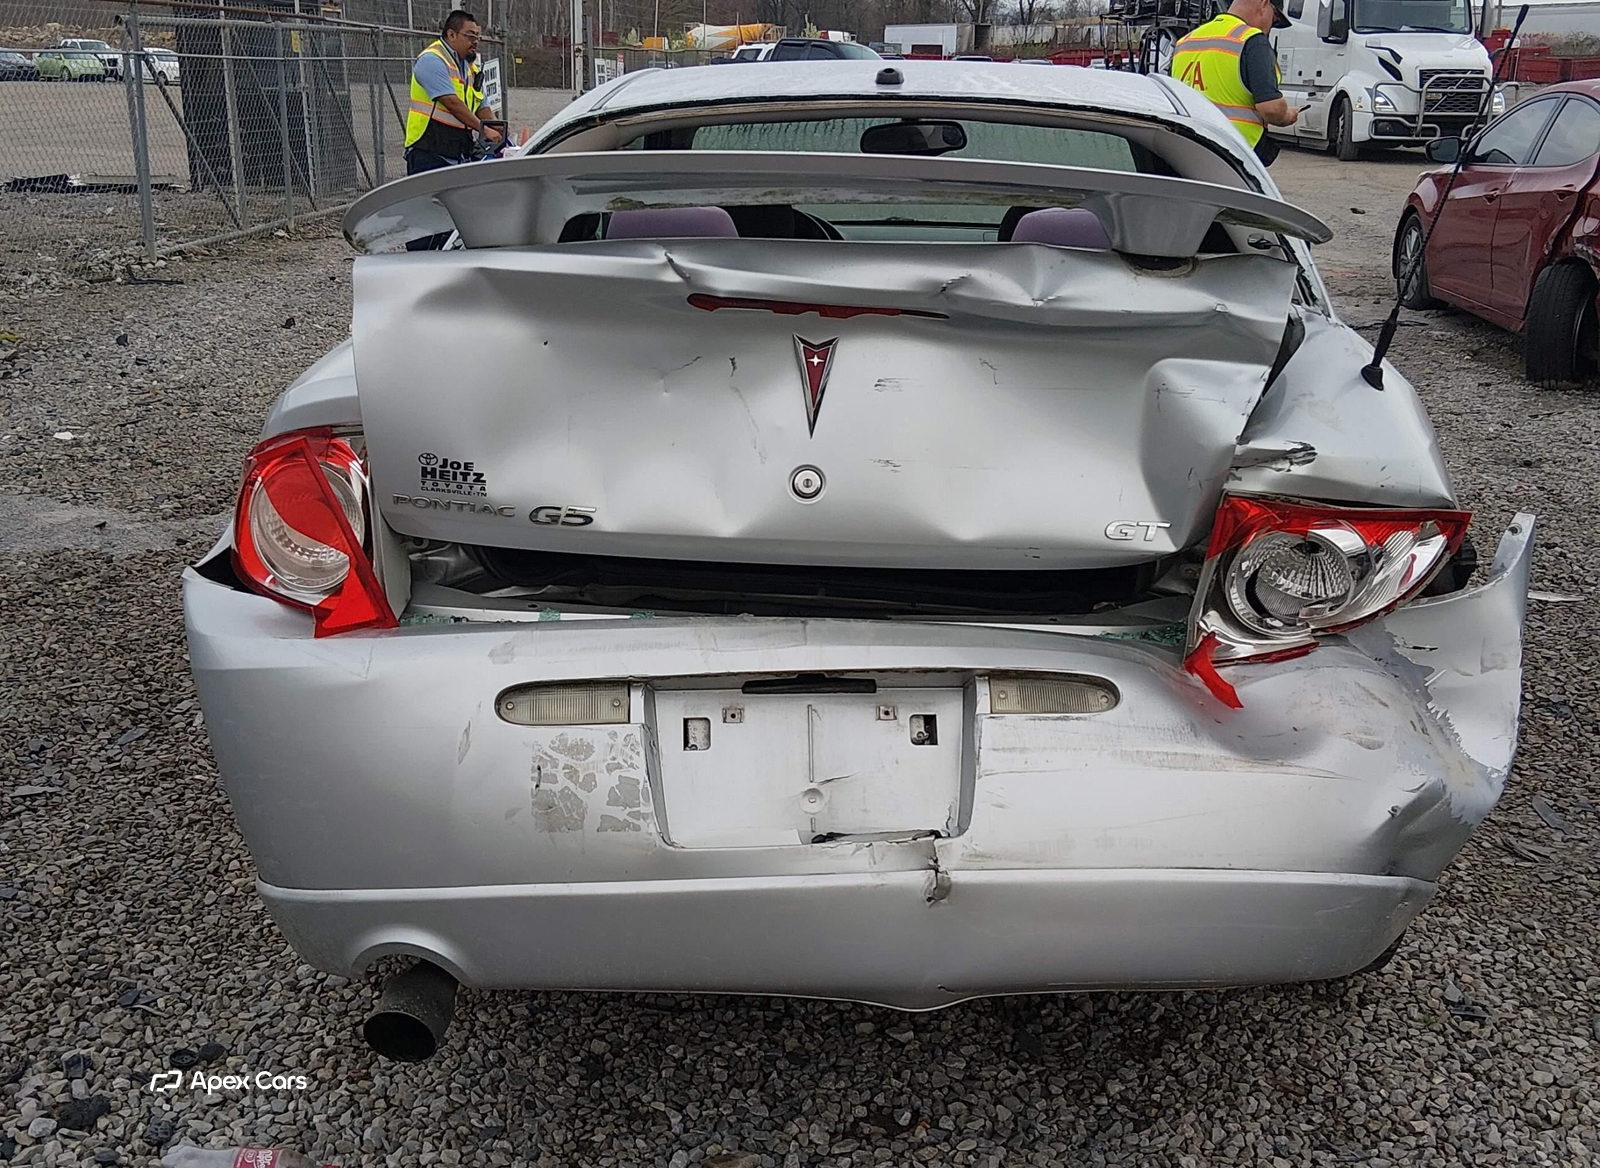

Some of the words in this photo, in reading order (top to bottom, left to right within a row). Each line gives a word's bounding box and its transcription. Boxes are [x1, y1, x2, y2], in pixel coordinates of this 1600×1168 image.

[439, 458, 475, 471] JOE
[421, 466, 487, 484] HEITZ
[421, 481, 486, 492] TOYOTA
[392, 493, 516, 518] PONTIAC
[528, 504, 597, 527] G5
[1104, 520, 1172, 542] GT
